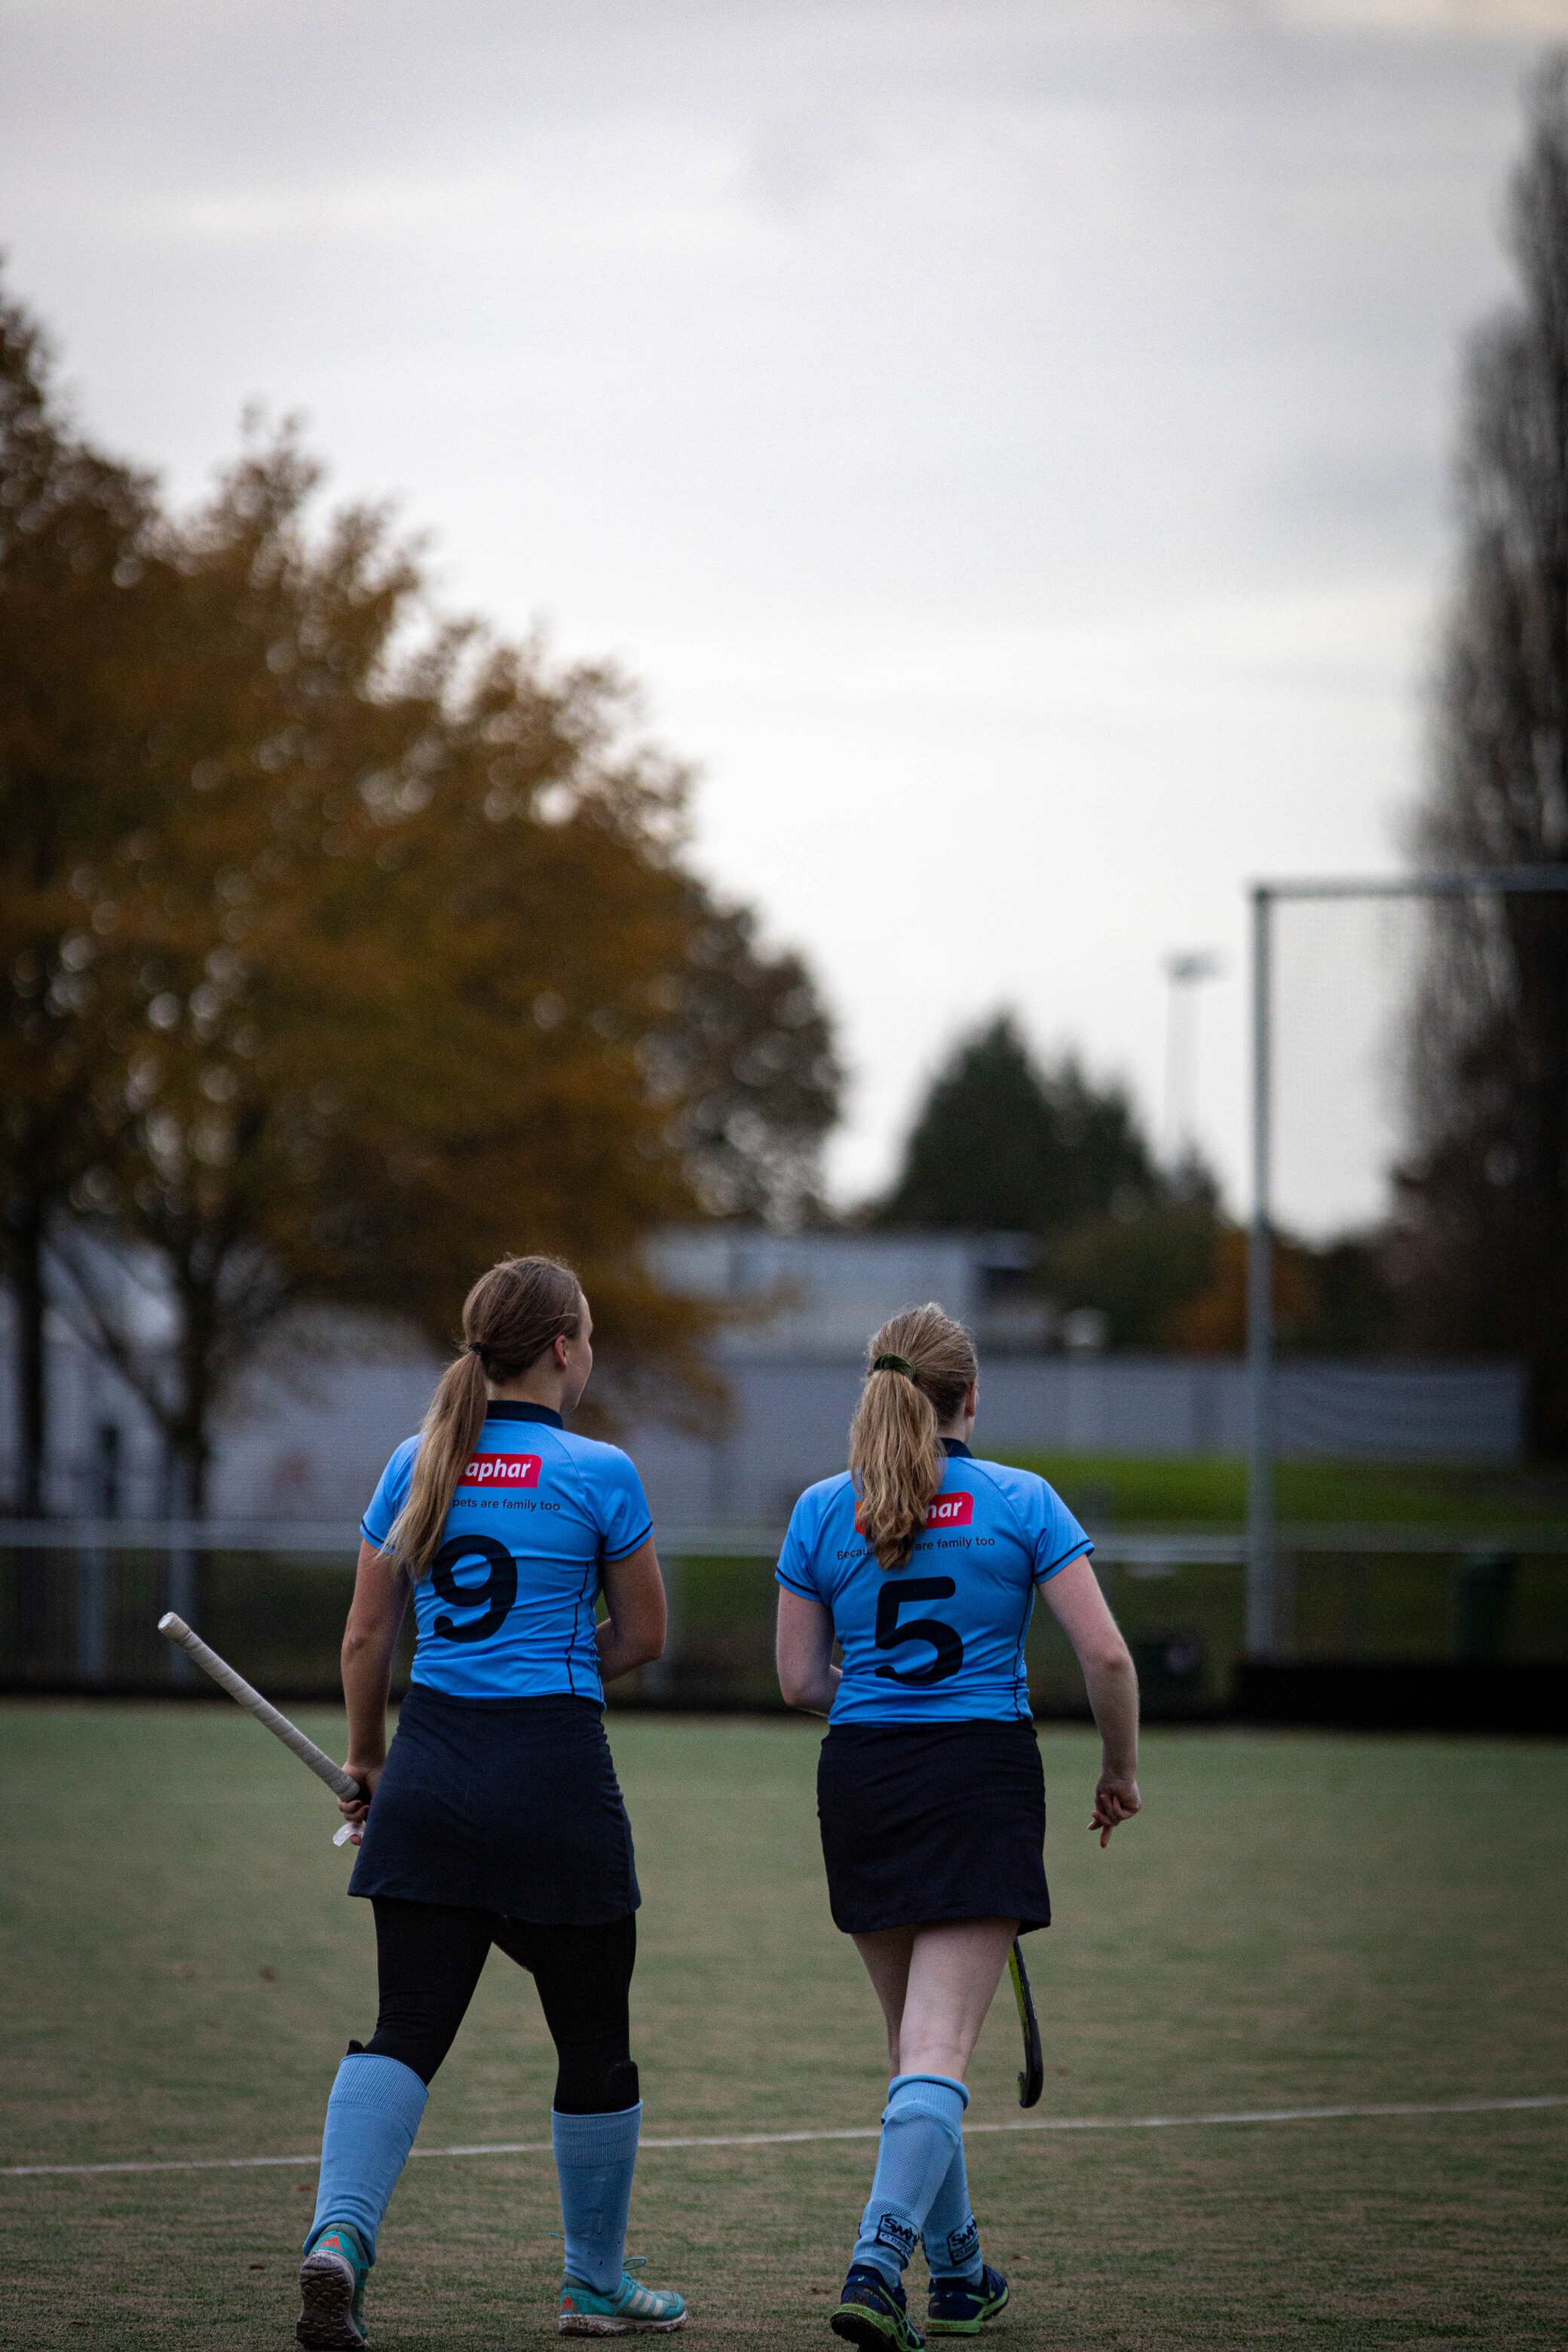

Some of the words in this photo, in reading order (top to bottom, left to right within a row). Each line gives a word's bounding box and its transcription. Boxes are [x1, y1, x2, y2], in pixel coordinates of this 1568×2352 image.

[465, 1459, 531, 1482] aphar
[452, 1498, 477, 1508] pets
[481, 1500, 499, 1508] are
[503, 1499, 536, 1511] family
[541, 1501, 560, 1511] too
[838, 1548, 873, 1560] Becau
[915, 1542, 933, 1551] are
[938, 1536, 972, 1549] family
[975, 1536, 995, 1546] too
[431, 1534, 518, 1643] 9
[875, 1576, 964, 1686] 5
